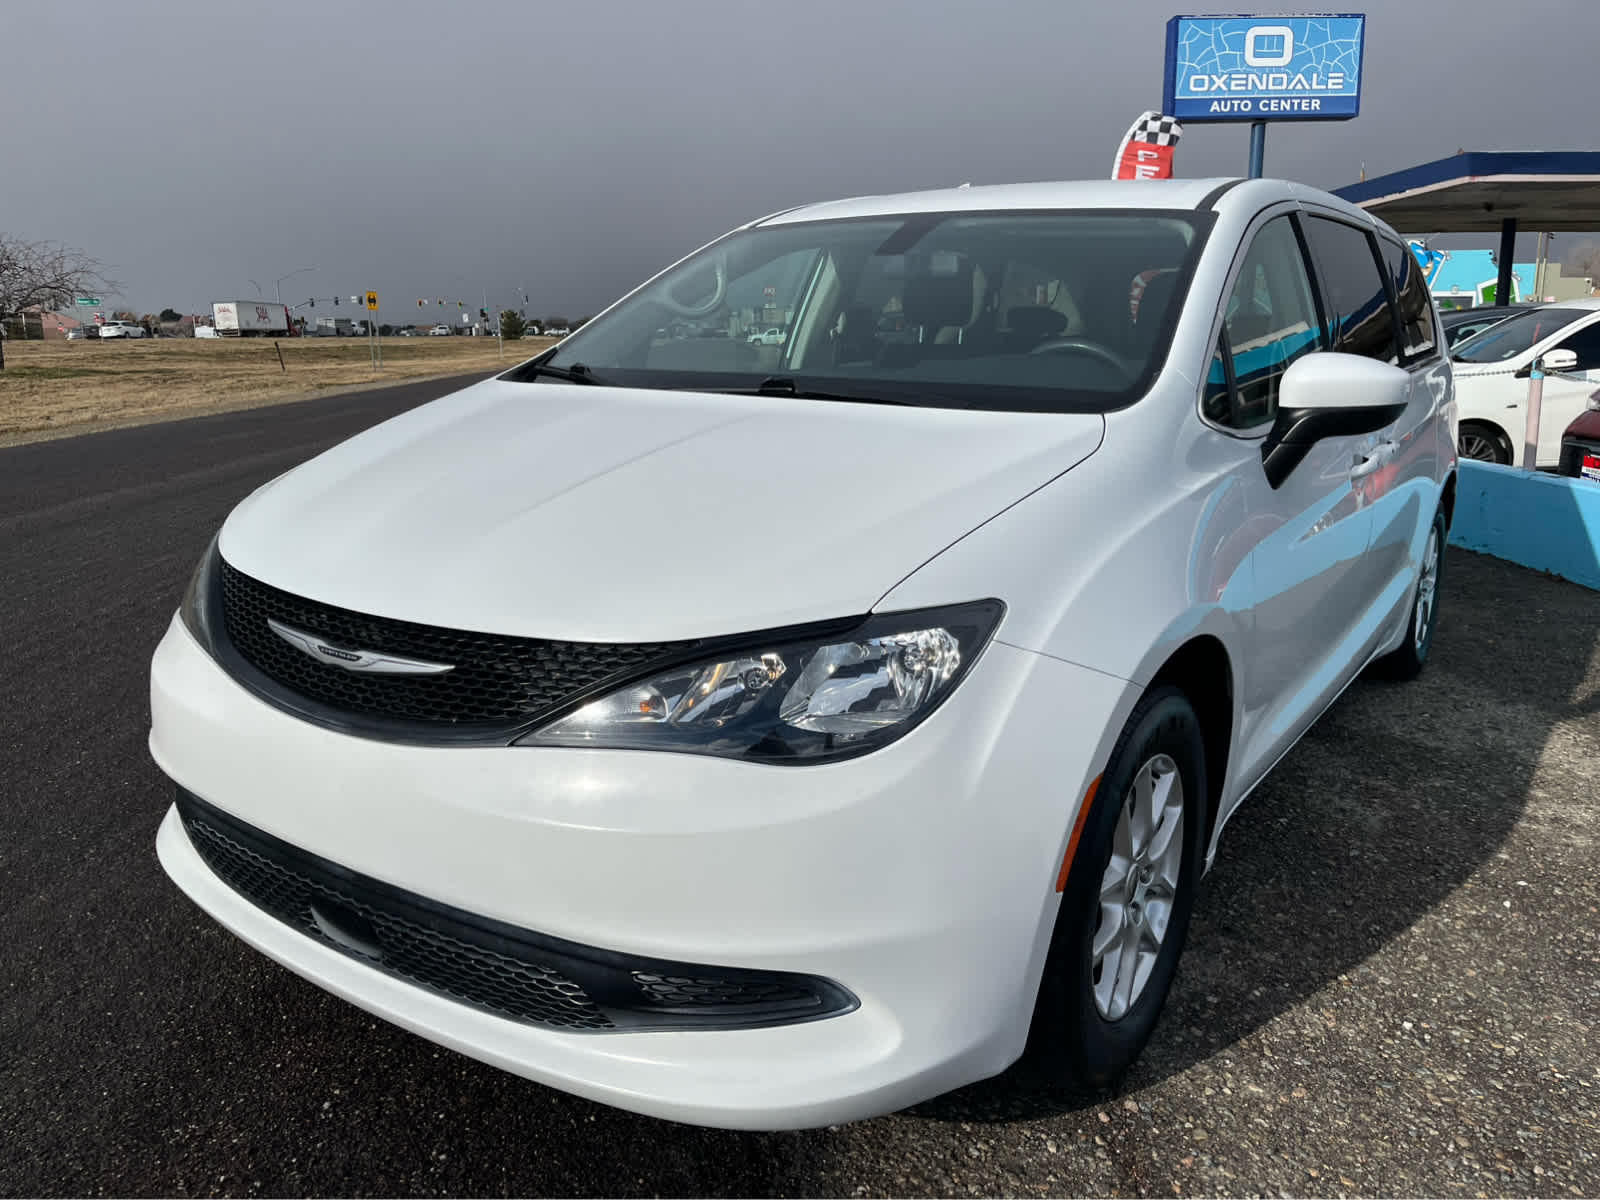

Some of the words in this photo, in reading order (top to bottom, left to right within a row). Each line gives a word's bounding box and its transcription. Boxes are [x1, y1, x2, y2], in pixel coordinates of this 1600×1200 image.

[1244, 26, 1294, 67] O
[1189, 73, 1345, 92] OXENDALE
[1210, 101, 1252, 112] AUTO
[1259, 99, 1321, 111] CENTER
